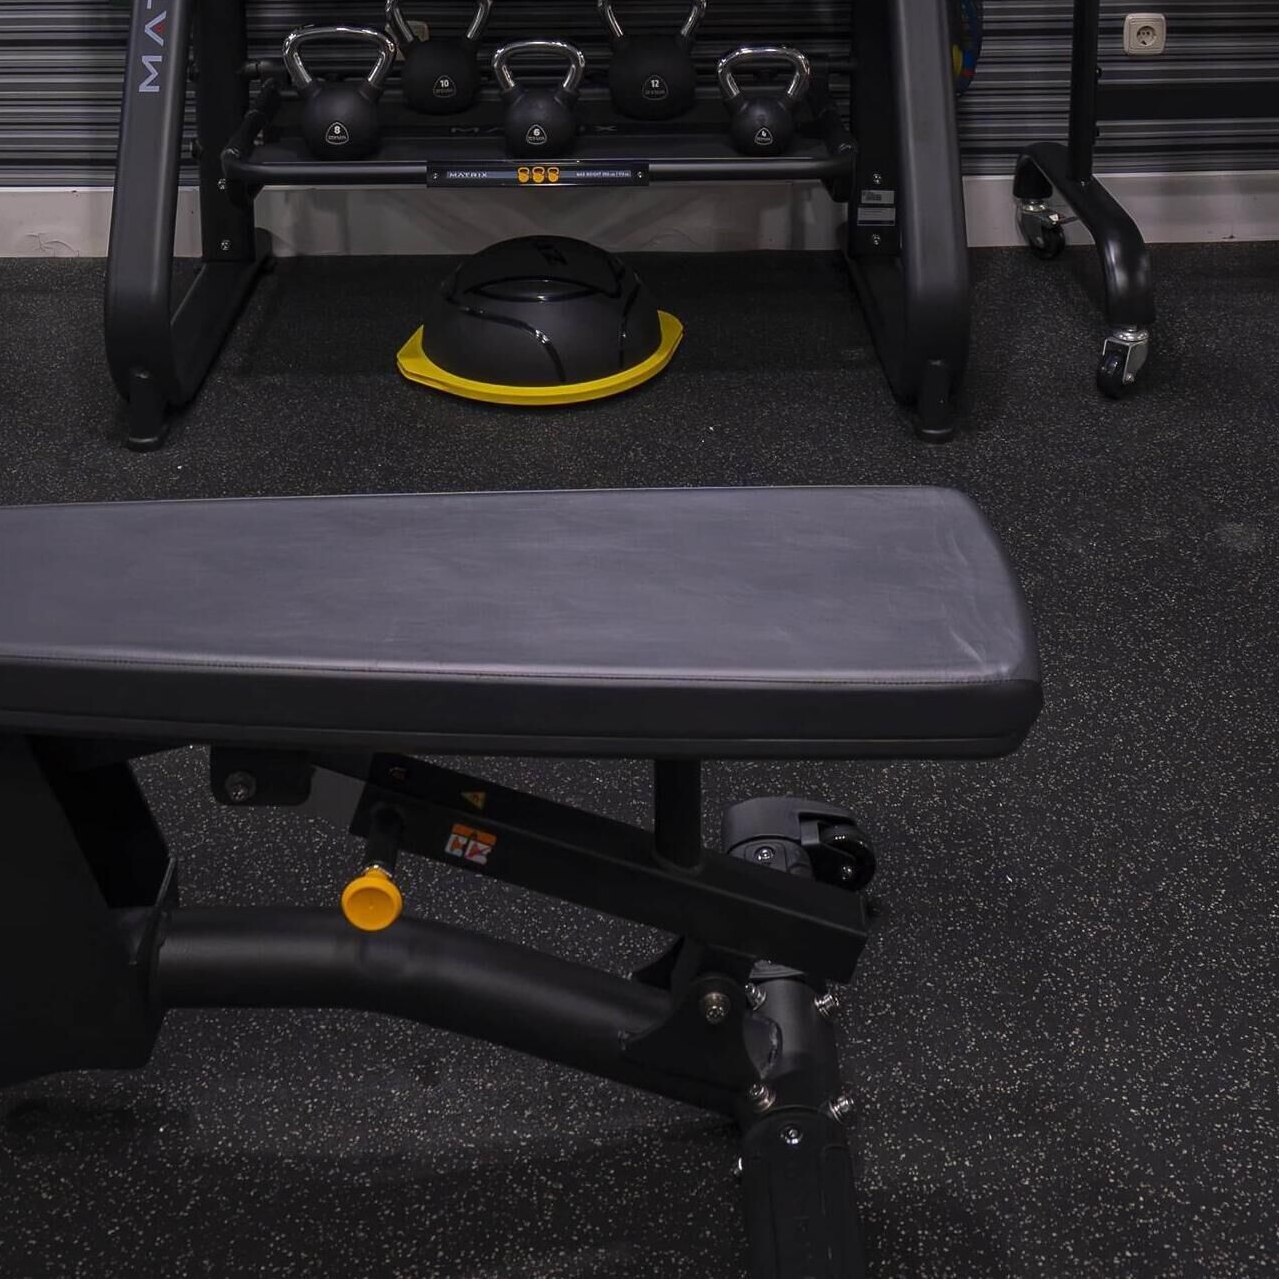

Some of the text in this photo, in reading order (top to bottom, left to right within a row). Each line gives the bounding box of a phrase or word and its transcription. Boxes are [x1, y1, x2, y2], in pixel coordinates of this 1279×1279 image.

[651, 80, 659, 88] 12
[334, 125, 341, 134] 8
[533, 128, 540, 136] 6
